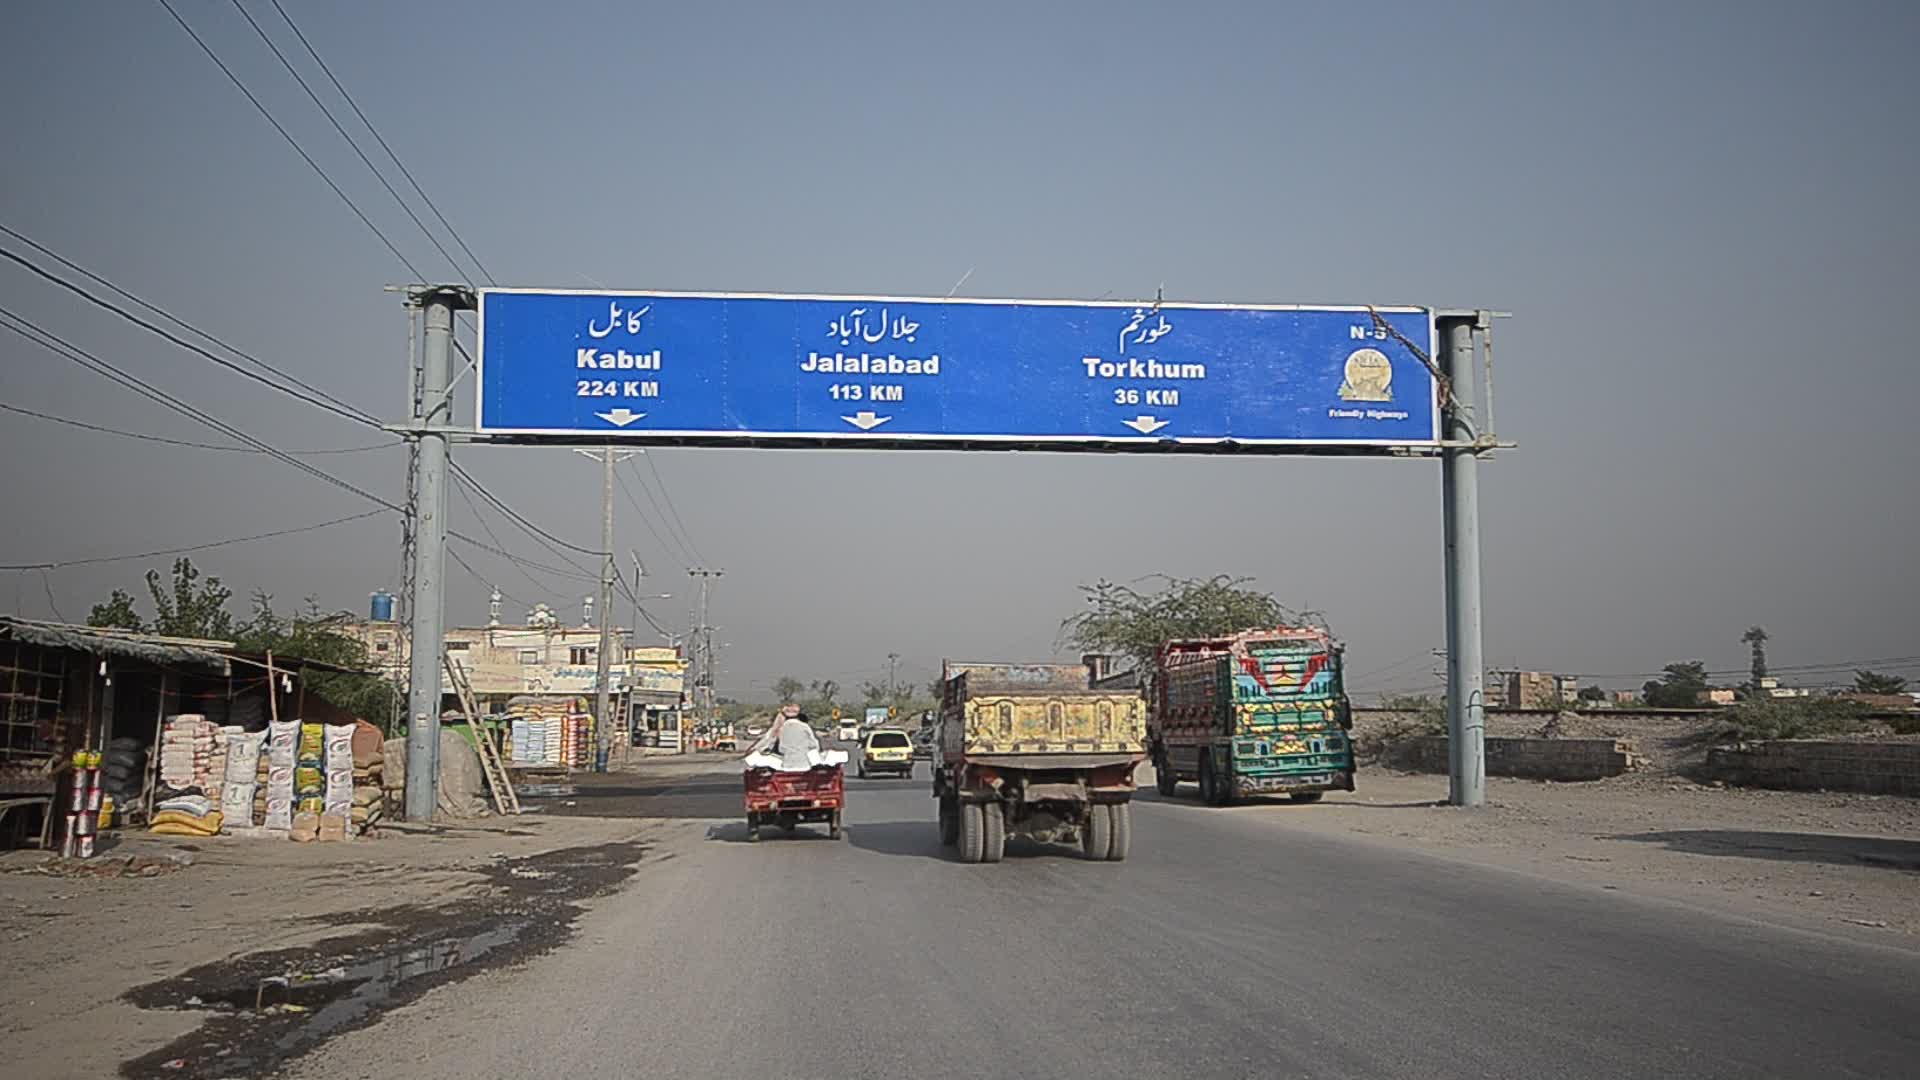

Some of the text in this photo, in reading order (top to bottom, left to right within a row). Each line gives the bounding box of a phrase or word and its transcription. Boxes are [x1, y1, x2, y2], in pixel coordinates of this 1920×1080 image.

[588, 302, 650, 338] کابل
[1119, 308, 1173, 354] طورخم
[576, 348, 662, 371] Kabul
[800, 352, 940, 376] Jalalabad
[1082, 357, 1206, 379] Torkhum
[577, 380, 659, 398] 224 KM
[829, 383, 904, 402] 113 KM
[1114, 388, 1180, 406] 36 KM
[1328, 408, 1409, 420] Friendly Highways
